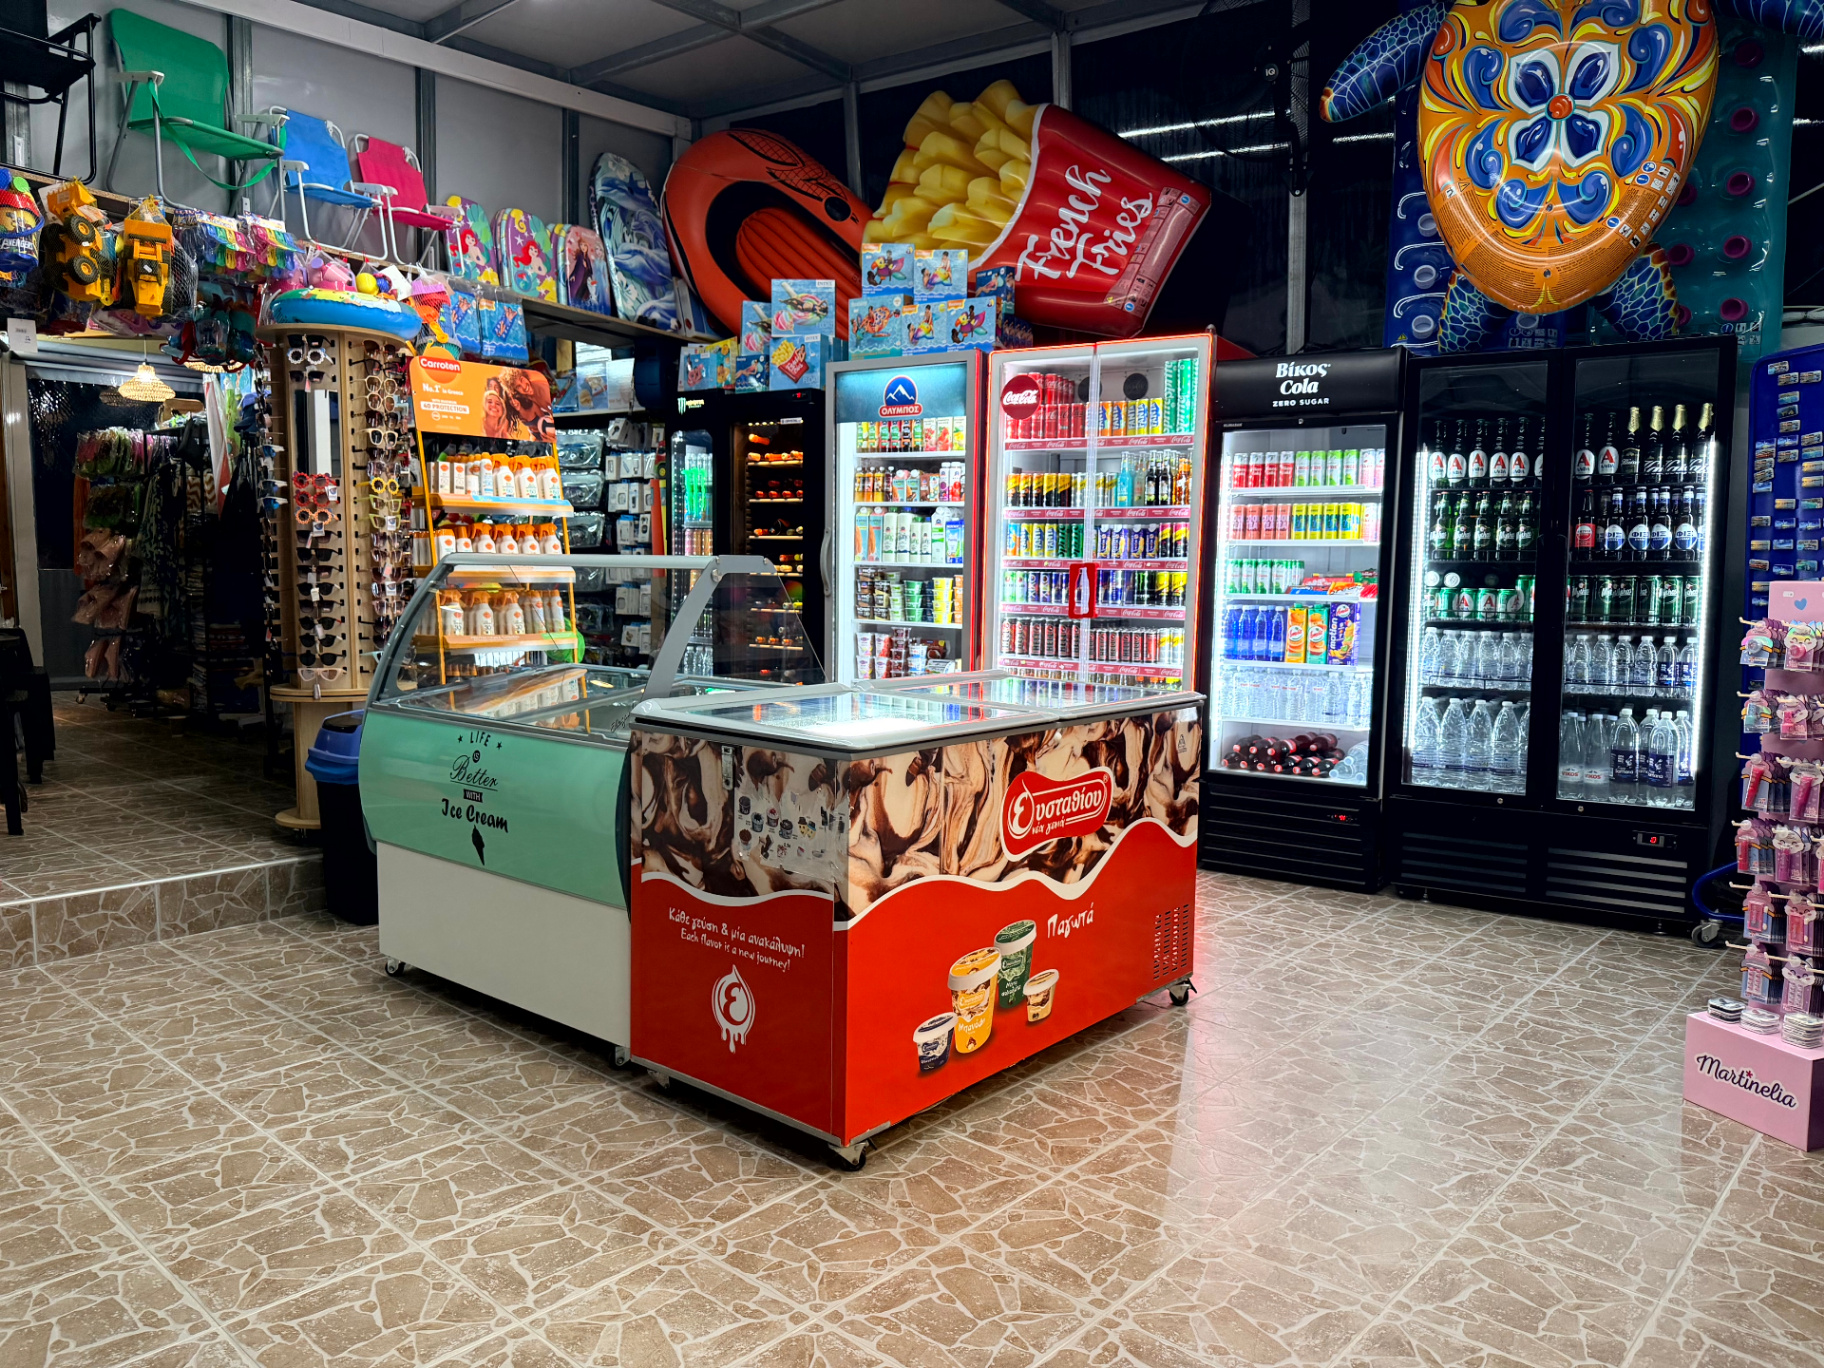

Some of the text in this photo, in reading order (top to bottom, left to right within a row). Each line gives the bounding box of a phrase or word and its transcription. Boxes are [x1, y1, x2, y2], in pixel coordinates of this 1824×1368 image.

[1014, 164, 1113, 282] French
[1065, 191, 1154, 279] Fries
[420, 358, 461, 372] Carroten
[1276, 361, 1328, 378] Βίκος
[1272, 397, 1330, 408] ZERO SUGAR
[1280, 378, 1319, 395] Cola
[432, 403, 468, 413] PROTECTION
[881, 406, 919, 416] ΟΛΥΜΠΟΣ
[1330, 617, 1338, 649] motion
[470, 730, 491, 747] LIFE
[450, 755, 499, 788] Better
[465, 790, 481, 801] WITH
[441, 798, 509, 833] Ice Cream
[669, 907, 806, 959] Κάθε γεύση & μία ανακάλυψη!
[1047, 901, 1094, 939] Παγωτά
[681, 927, 791, 973] Each flavor is a new journey!
[1696, 1054, 1797, 1108] Martinelia
